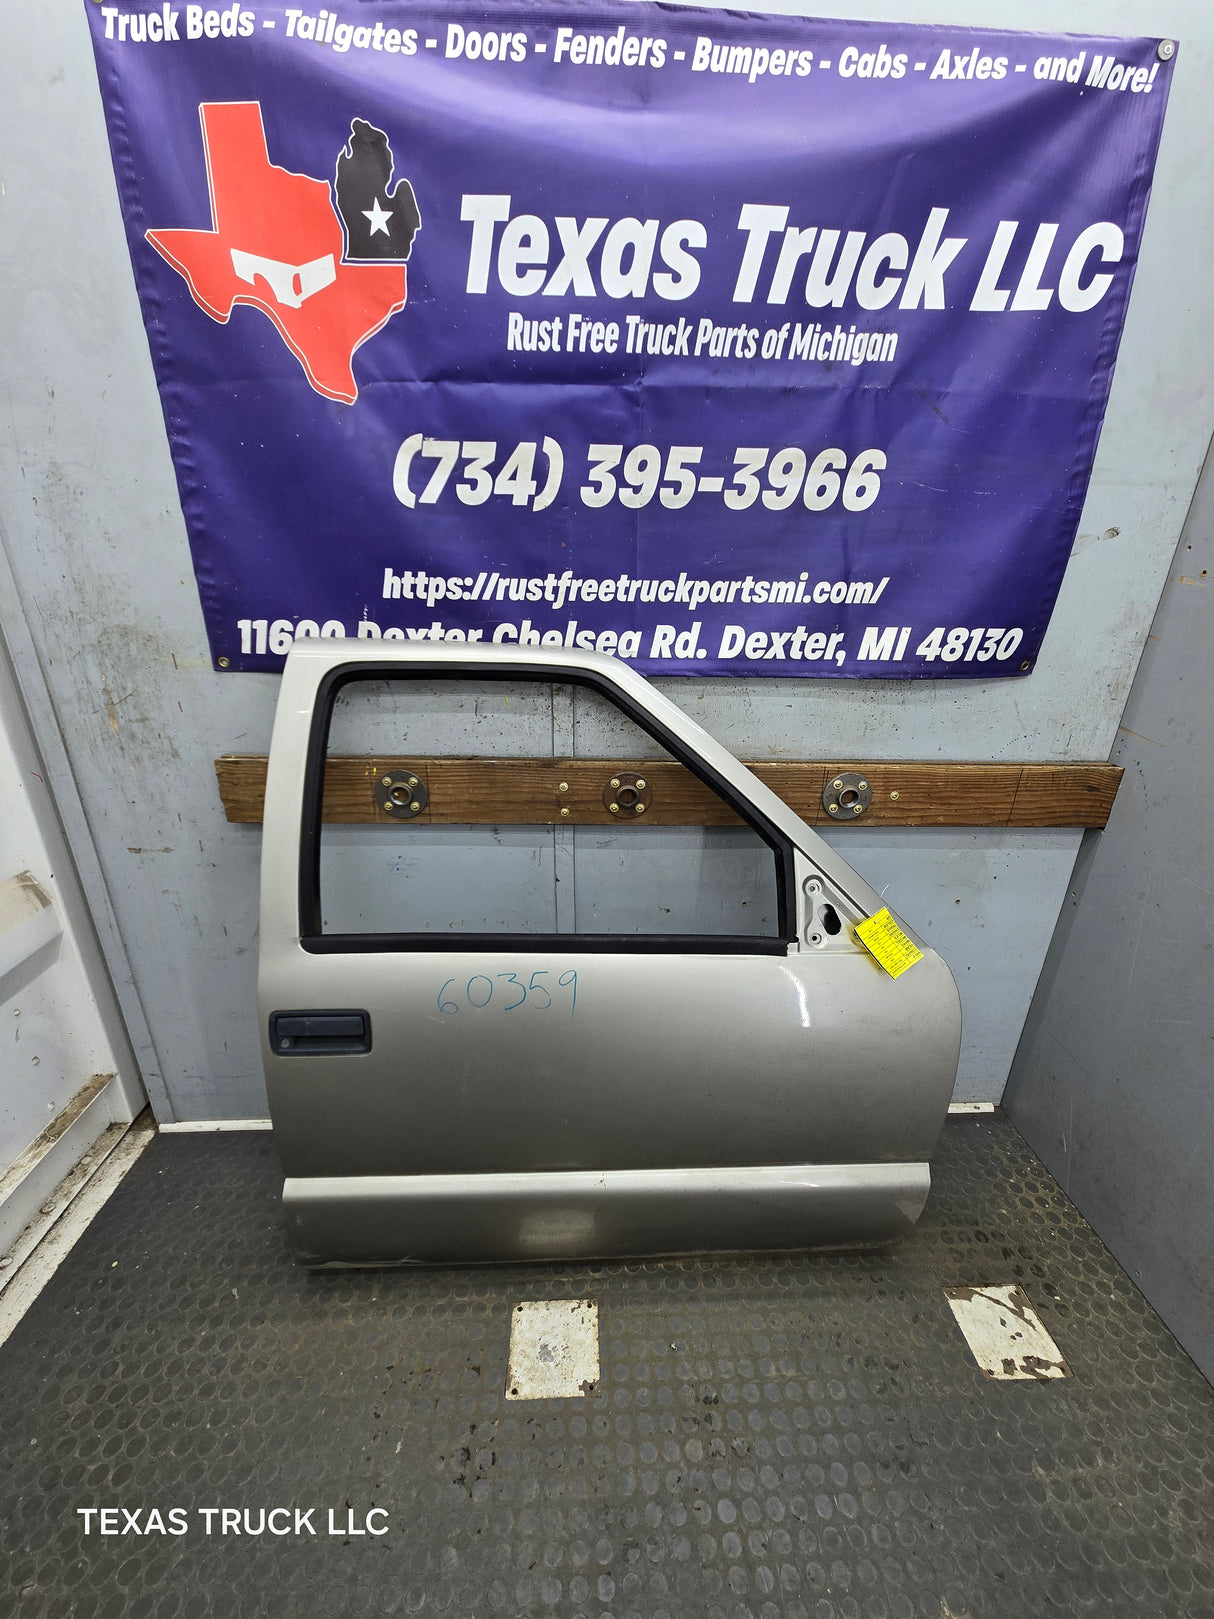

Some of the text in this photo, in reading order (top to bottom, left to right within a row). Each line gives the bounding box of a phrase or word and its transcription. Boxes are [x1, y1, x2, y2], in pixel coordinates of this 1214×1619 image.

[101, 3, 180, 42] Truck
[186, 3, 255, 40] Beds
[285, 9, 418, 56] Tailgates
[445, 24, 527, 63] Doors
[554, 26, 668, 67] Fenders
[692, 37, 813, 83] Bumpers
[838, 44, 908, 79] Cabs
[929, 47, 1008, 80] Axles
[1033, 51, 1086, 84] and
[1085, 55, 1160, 93] More!
[460, 194, 1124, 313] Texas Truck LLC
[507, 312, 899, 367] Rust Free Truck Parts of Michigan
[393, 433, 887, 511] (734) 395-3966
[382, 567, 890, 610] https://rustfreetruckpartsmi.com/
[492, 619, 643, 659] Chelsea
[649, 621, 708, 659] Rd.
[718, 625, 846, 667] Dexter,
[857, 627, 912, 662] MI
[916, 627, 1024, 662] 48130
[437, 969, 577, 1016] 60359
